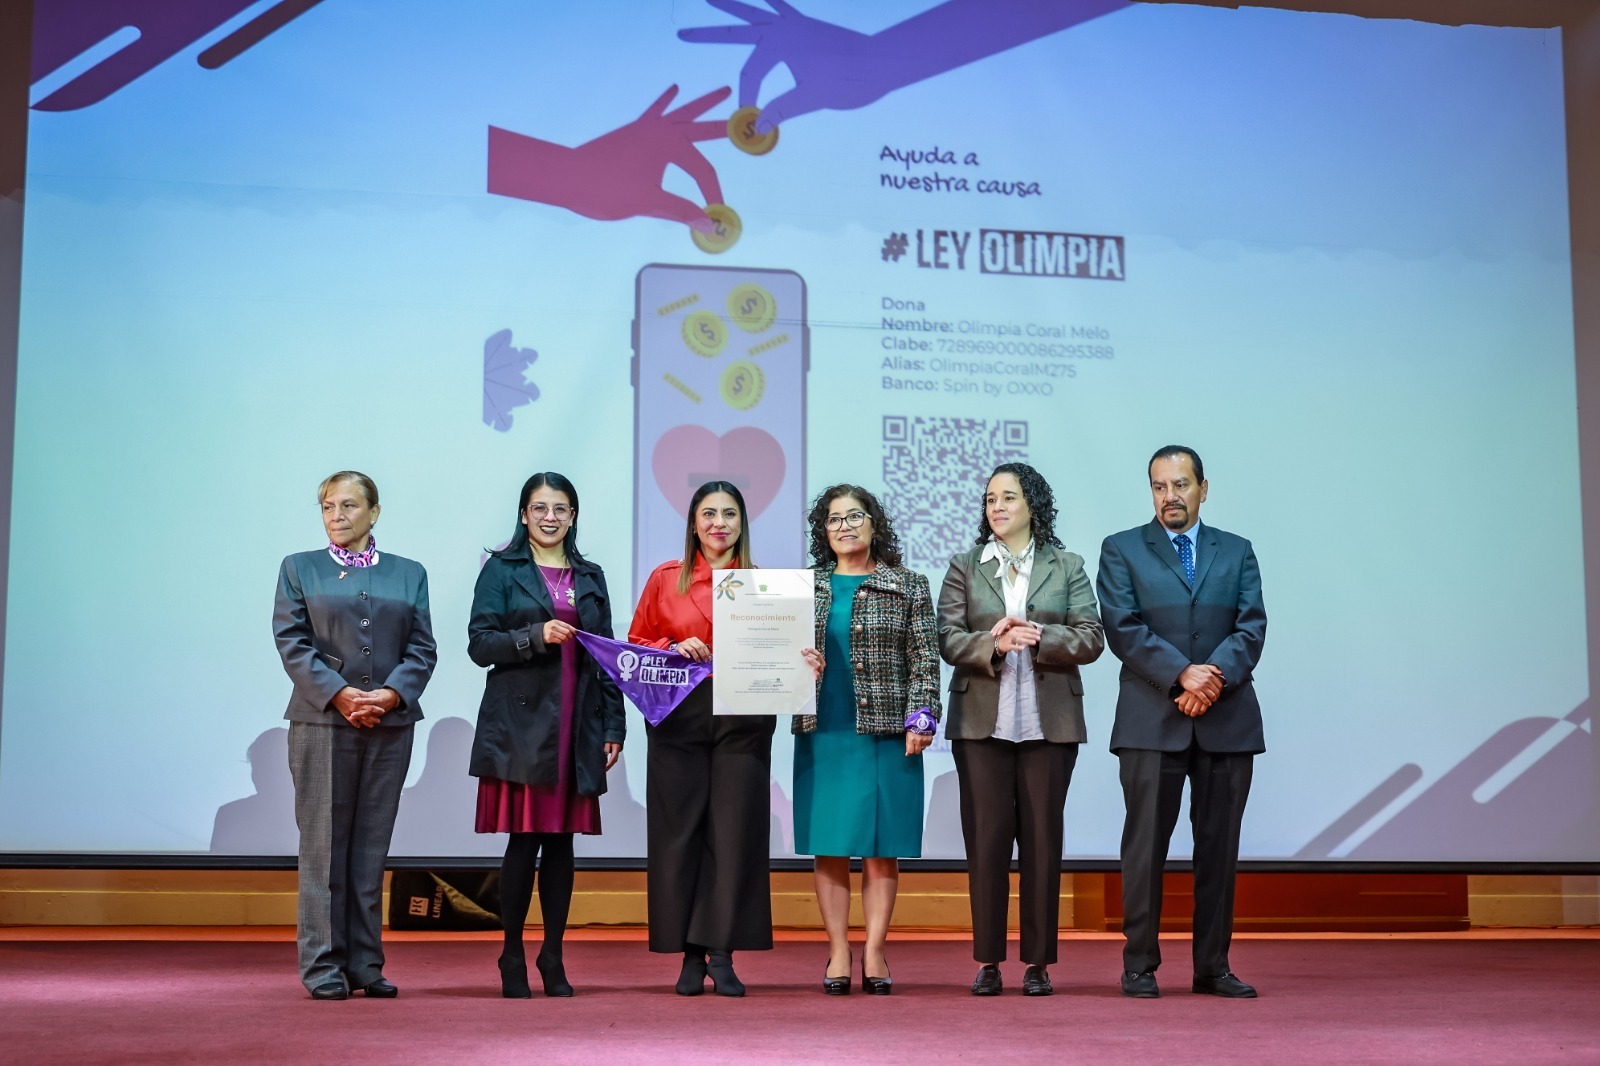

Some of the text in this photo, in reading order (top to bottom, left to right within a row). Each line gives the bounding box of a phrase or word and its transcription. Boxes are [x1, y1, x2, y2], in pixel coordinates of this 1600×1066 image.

[880, 145, 979, 170] Ayuda a
[881, 172, 1042, 197] nuestra causa
[981, 231, 1123, 279] OLIMPIA
[882, 297, 926, 311] Dona
[882, 317, 1109, 340] Nombre: Olimpia Coral Melo
[881, 337, 933, 351] Clabe:
[882, 356, 925, 370] Alias:
[882, 376, 1054, 397] Banco: Spin by OXXO
[730, 614, 796, 622] Reconocimiento
[640, 655, 668, 668] #LEY
[641, 668, 687, 684] OLIMPIA
